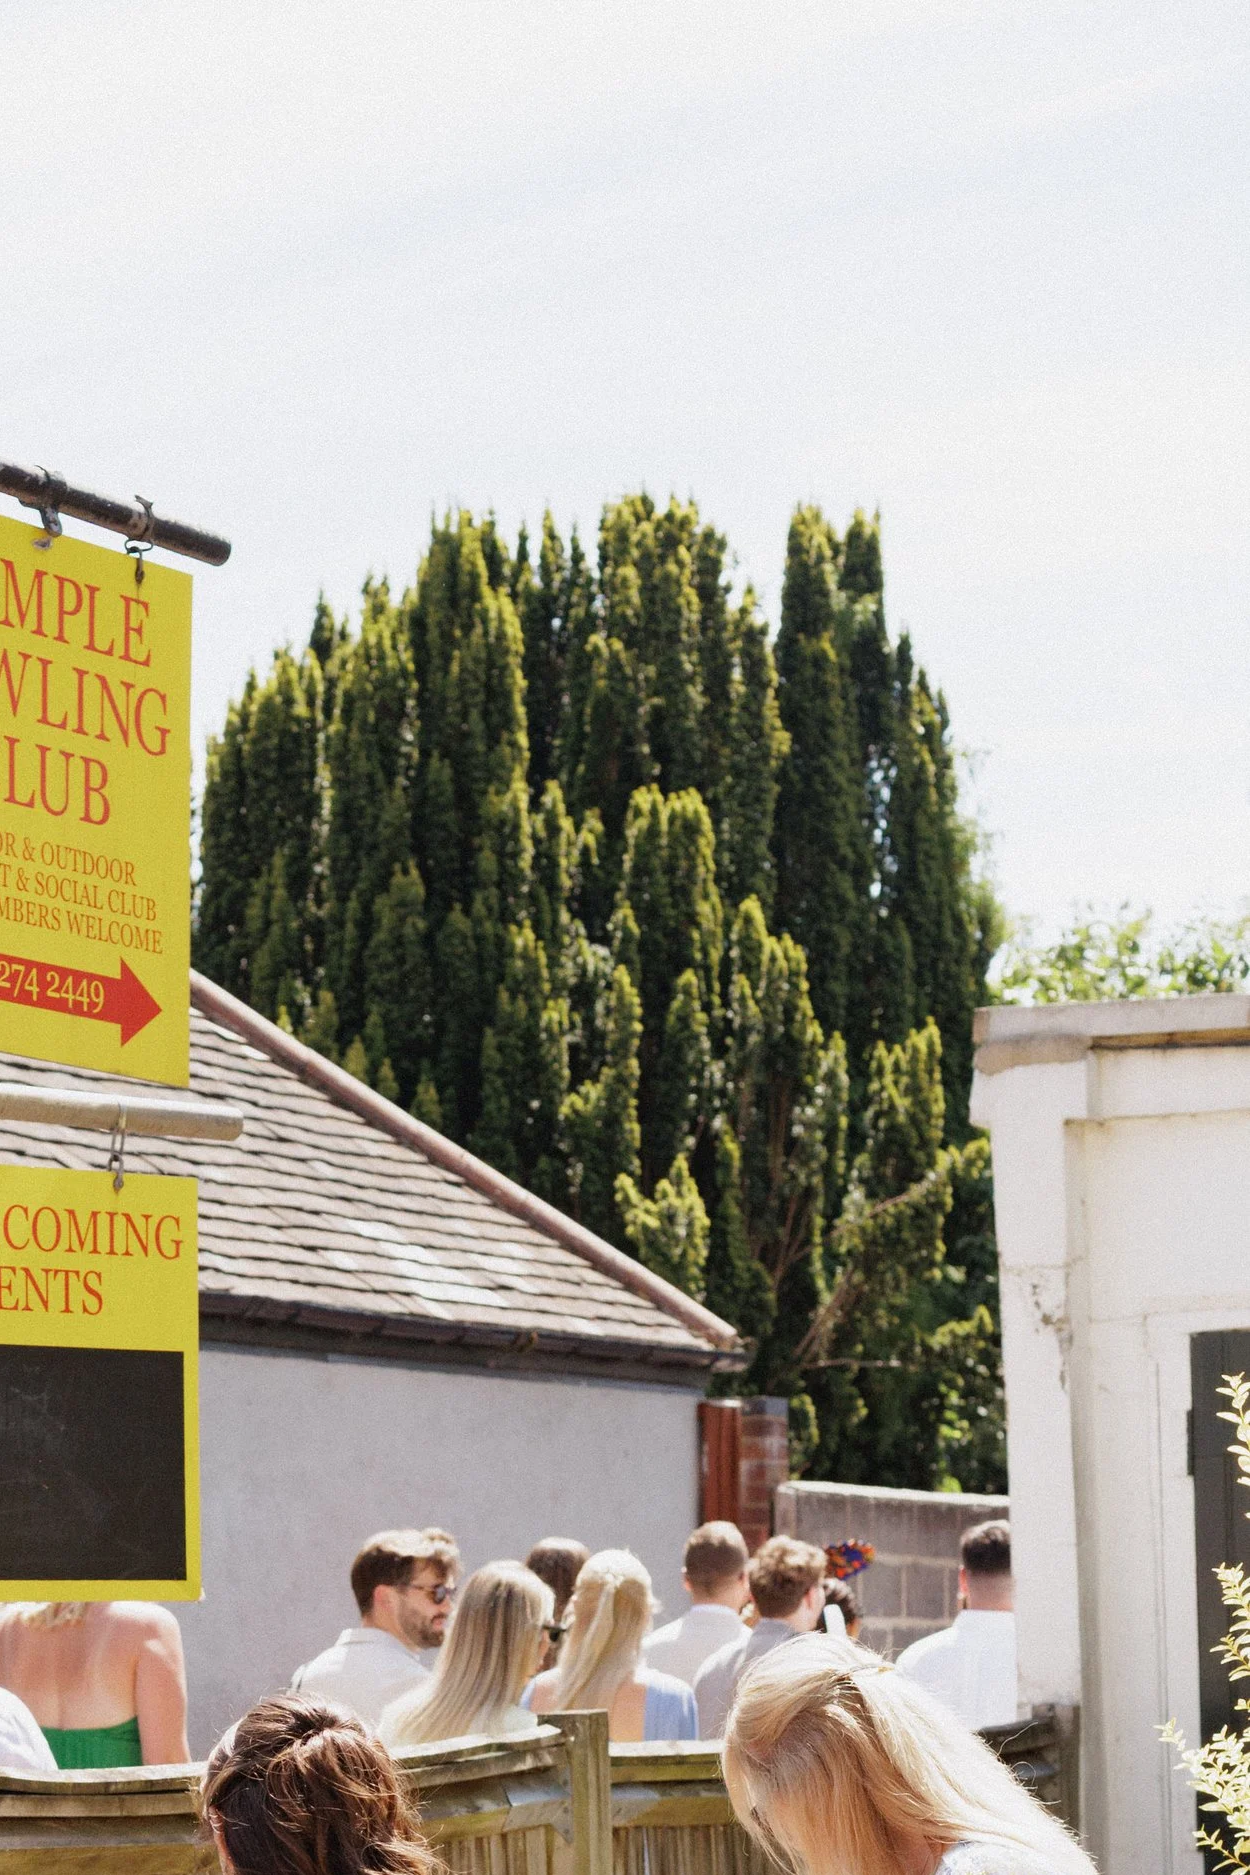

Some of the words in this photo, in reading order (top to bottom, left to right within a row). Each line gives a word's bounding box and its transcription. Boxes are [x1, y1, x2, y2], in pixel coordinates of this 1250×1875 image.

[22, 837, 35, 862] &
[40, 841, 138, 886] OUTDOOR
[16, 867, 30, 892] &
[34, 871, 103, 910] SOCIAL
[107, 889, 157, 921] CLUB
[66, 910, 163, 955] WELCOME
[46, 971, 105, 1014] 2449
